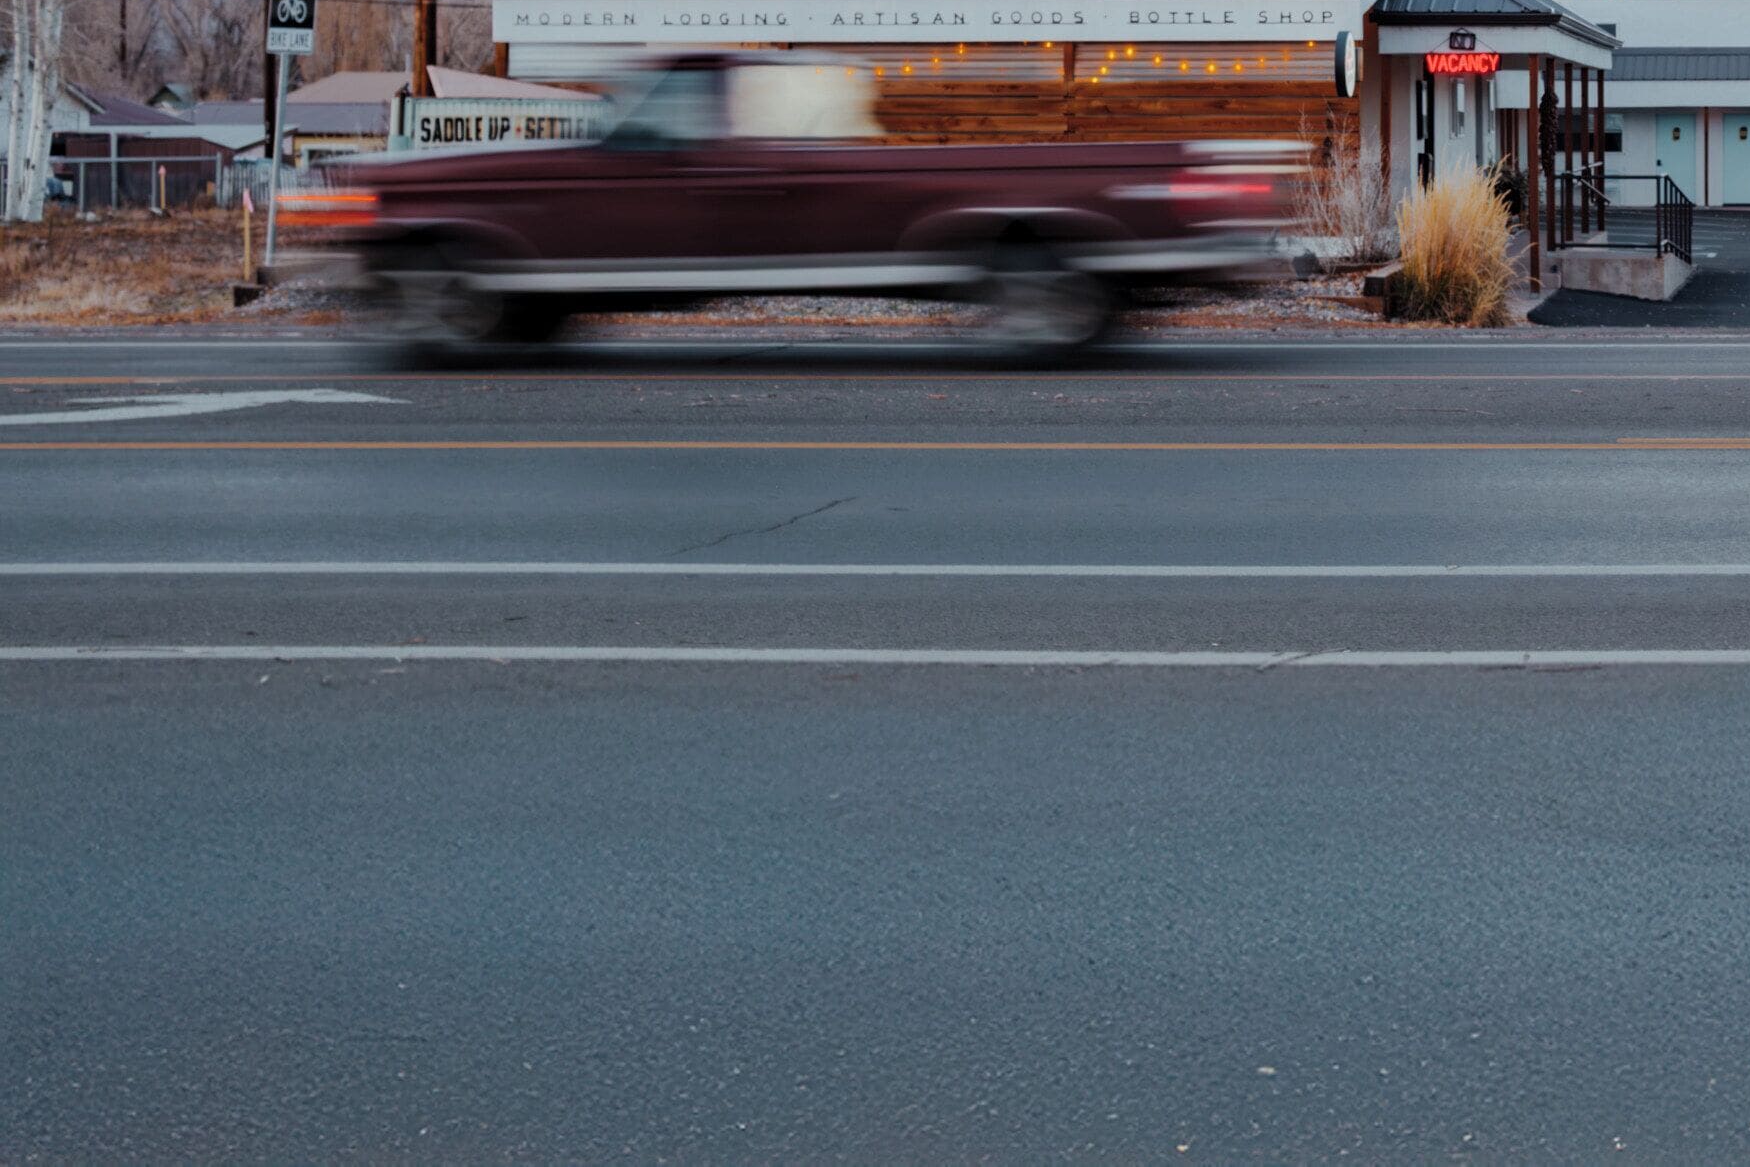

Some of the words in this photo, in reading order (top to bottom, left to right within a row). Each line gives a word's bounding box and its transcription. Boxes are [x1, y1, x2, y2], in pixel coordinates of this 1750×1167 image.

[516, 12, 636, 26] MODERN
[663, 12, 789, 26] LODGING
[833, 12, 966, 26] ARTISAN
[991, 11, 1085, 25] GOODS
[1129, 11, 1235, 24] BOTTLE
[1258, 11, 1334, 24] SHOP
[270, 32, 287, 47] BIKE
[290, 33, 311, 48] LANE
[1451, 35, 1474, 49] NO
[1426, 53, 1499, 73] VACANCY
[420, 117, 483, 143] SADDLE
[488, 117, 511, 141] UP
